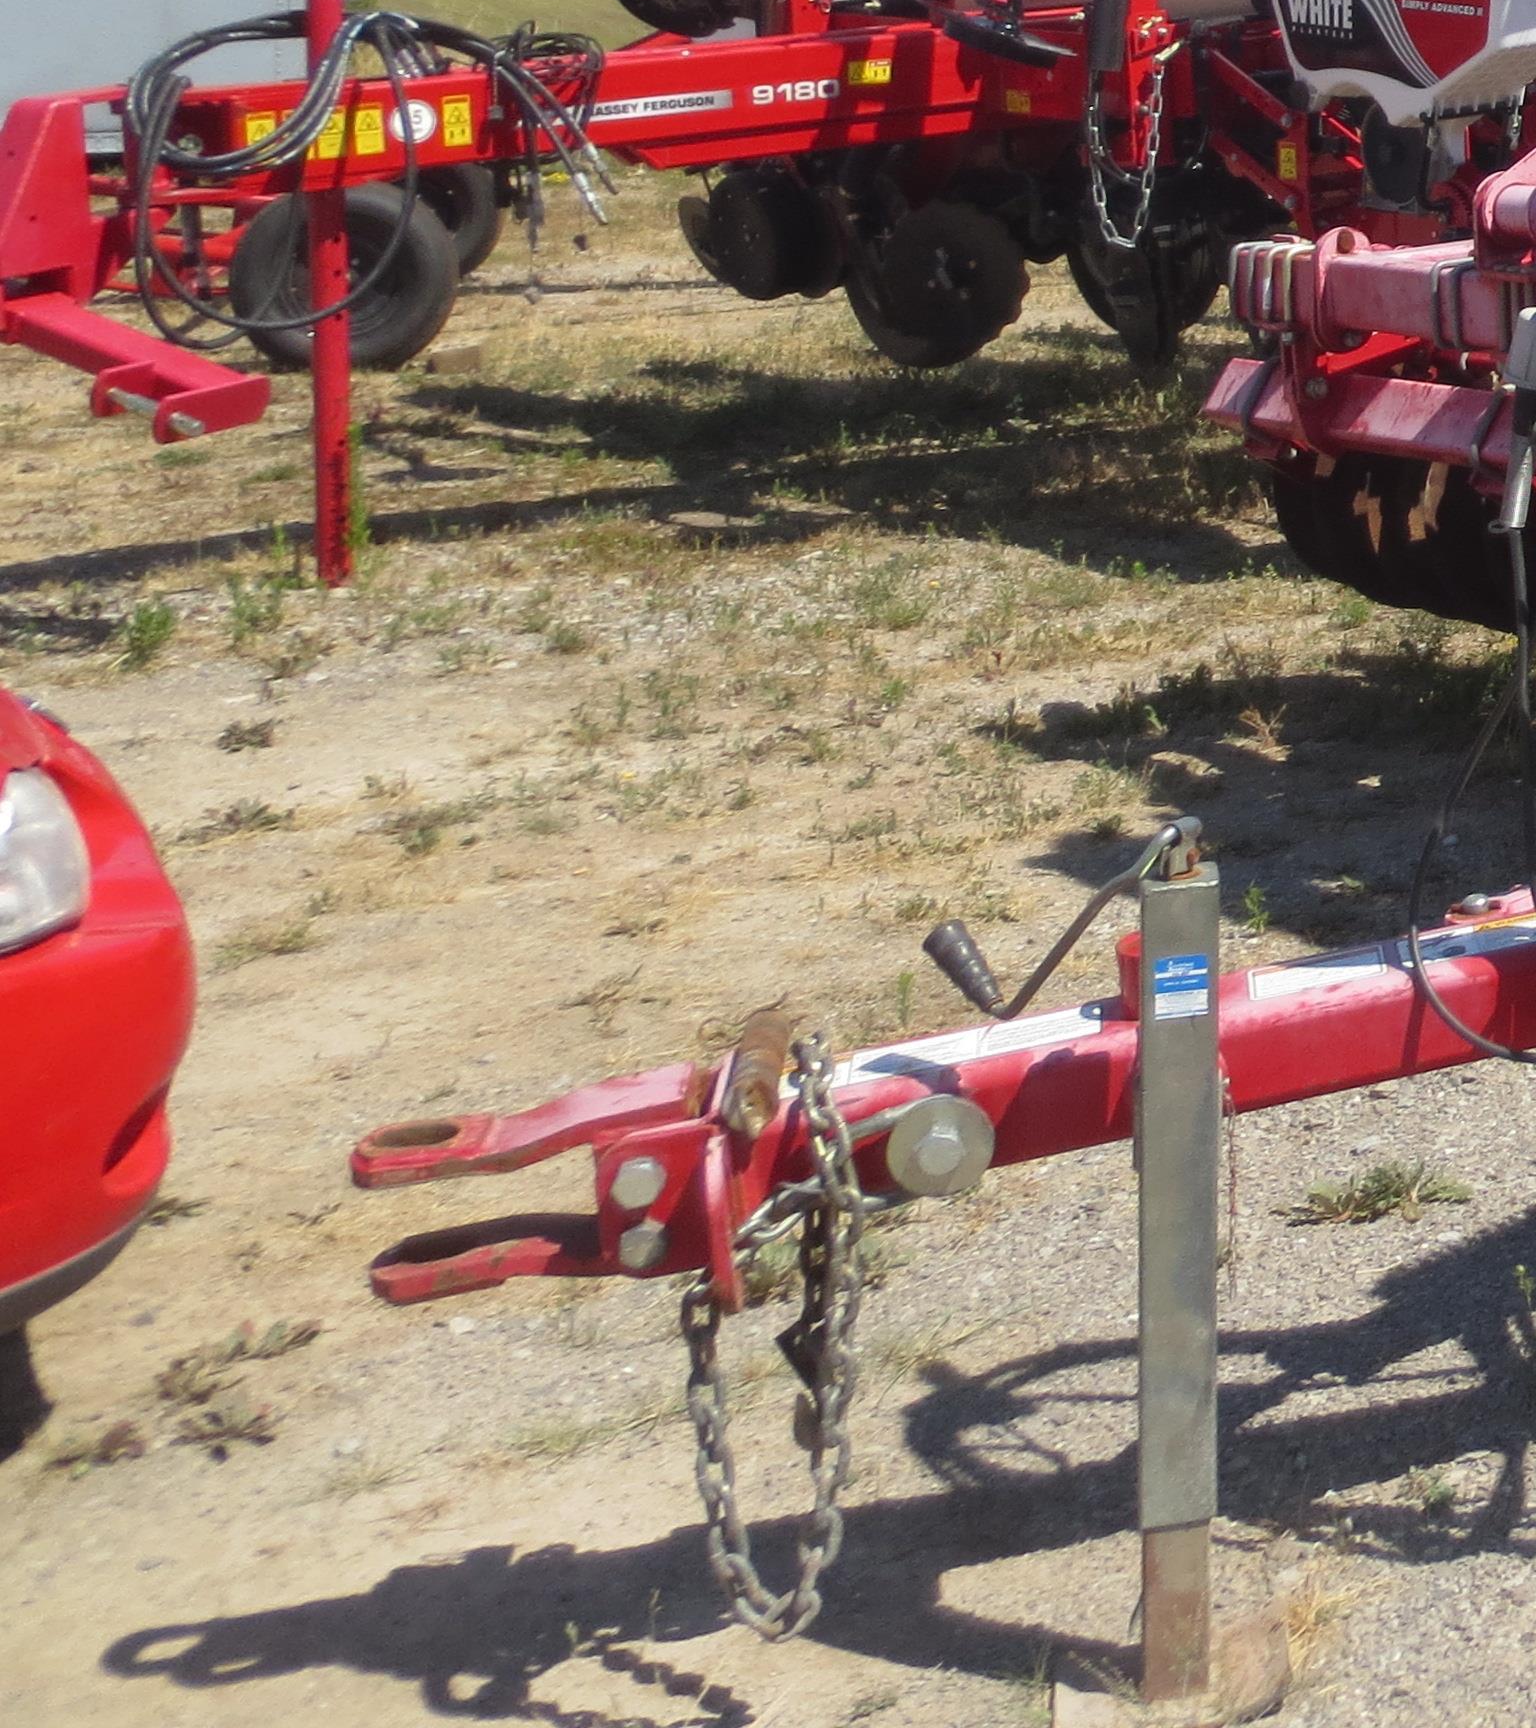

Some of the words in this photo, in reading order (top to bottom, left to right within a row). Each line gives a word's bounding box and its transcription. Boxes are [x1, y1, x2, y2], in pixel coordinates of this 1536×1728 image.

[1431, 3, 1475, 16] ADVANCED
[752, 78, 840, 105] 9180
[593, 102, 638, 116] ASSEY
[643, 95, 715, 111] FERGUSON
